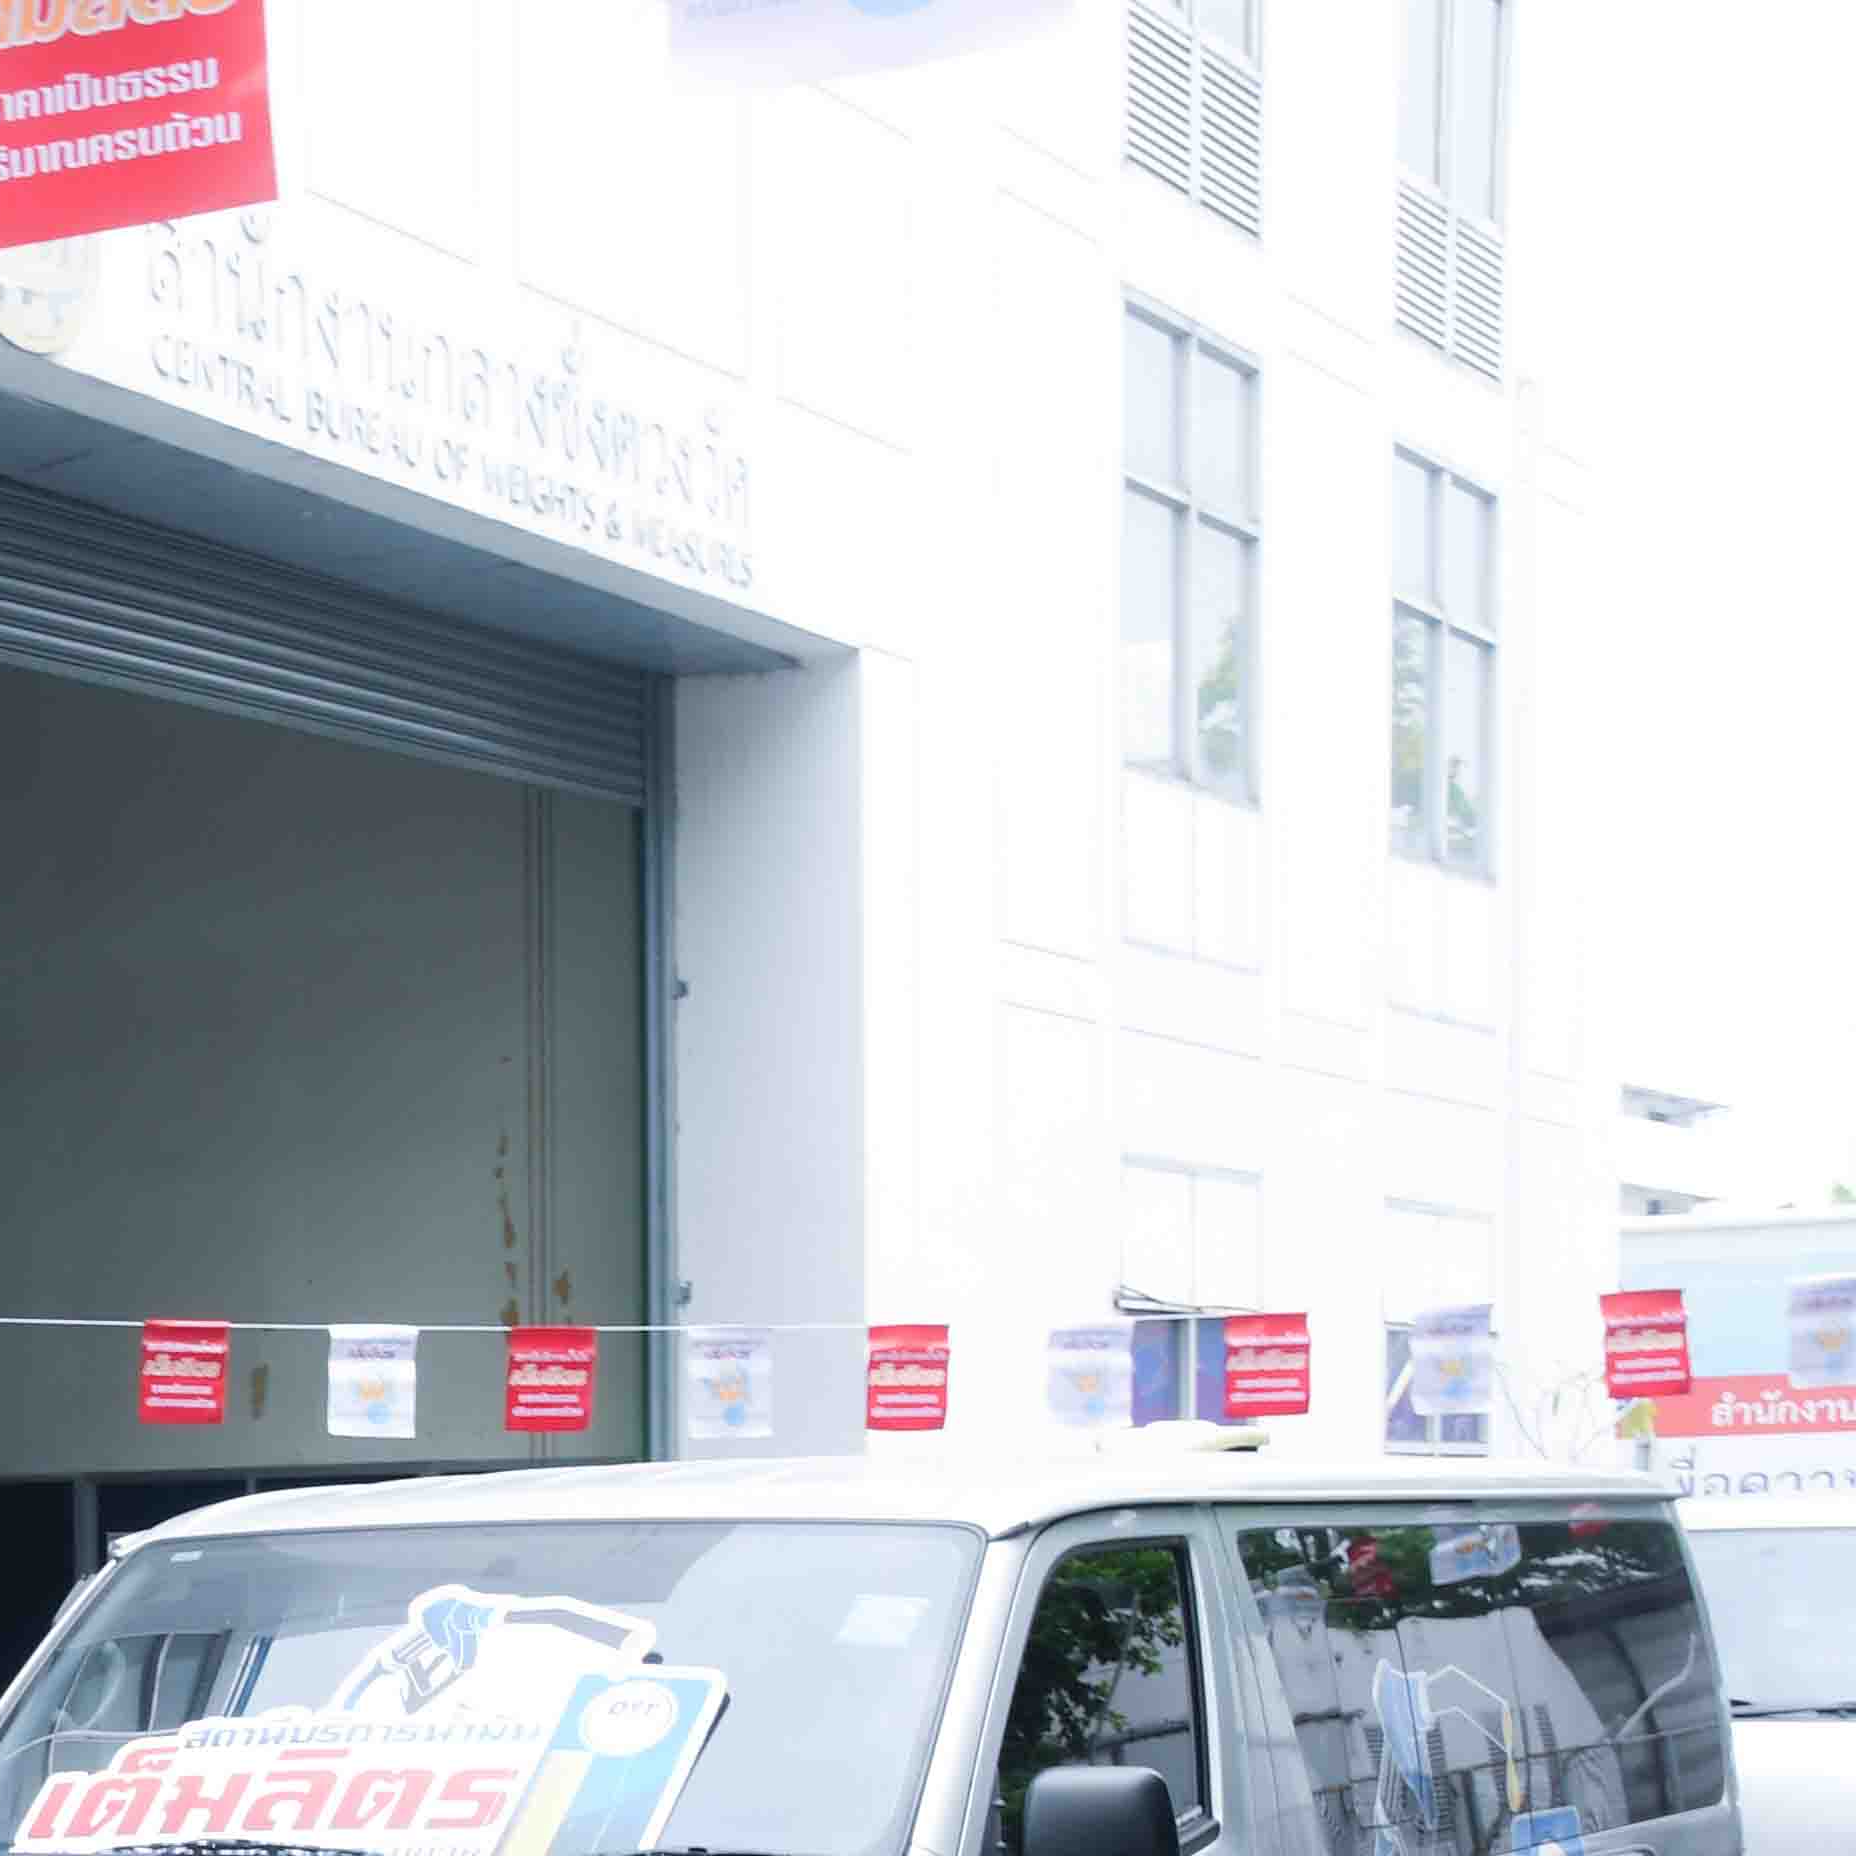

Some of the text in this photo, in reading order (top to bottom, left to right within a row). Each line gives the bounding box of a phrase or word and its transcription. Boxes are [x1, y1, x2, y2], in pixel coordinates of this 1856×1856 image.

[149, 333, 754, 587] CENTRAL BUREAU OF WEIGHTS & MEASURES
[184, 1702, 547, 1750] สถานีบริการน้ำมัน
[28, 1745, 516, 1839] เต็มลิตร
